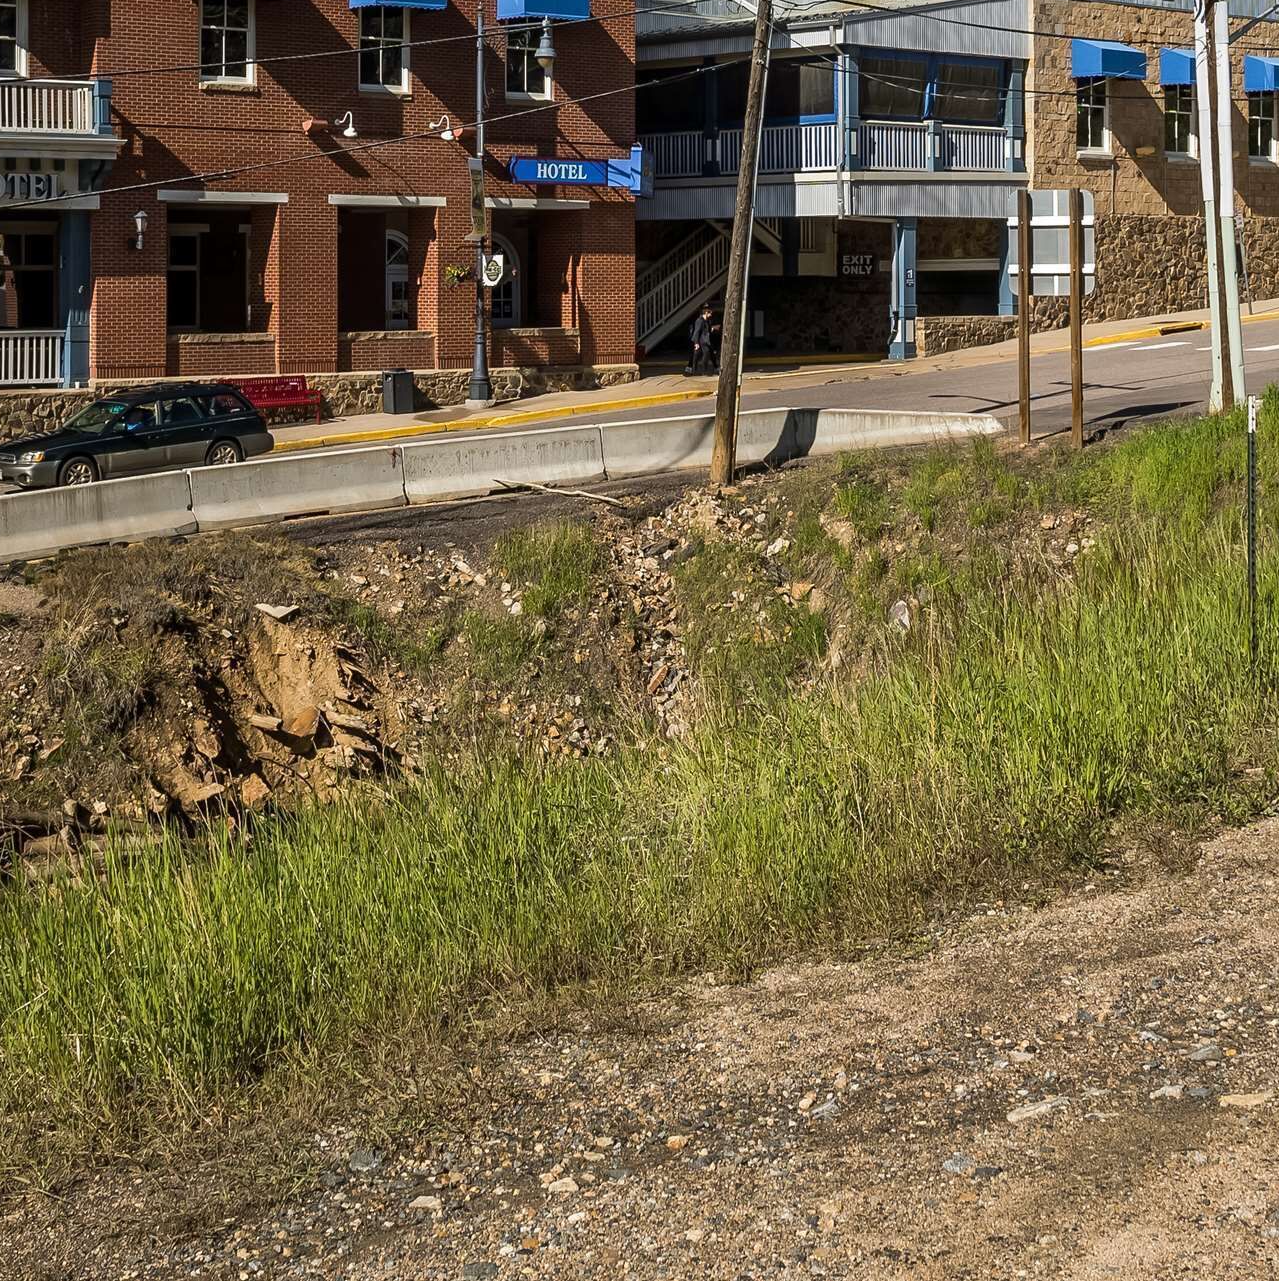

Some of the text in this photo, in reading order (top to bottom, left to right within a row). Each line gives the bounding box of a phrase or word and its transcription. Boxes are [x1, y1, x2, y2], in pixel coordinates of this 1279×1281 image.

[536, 163, 588, 180] HOTEL
[842, 255, 873, 265] EXIT
[842, 265, 873, 275] ONLY
